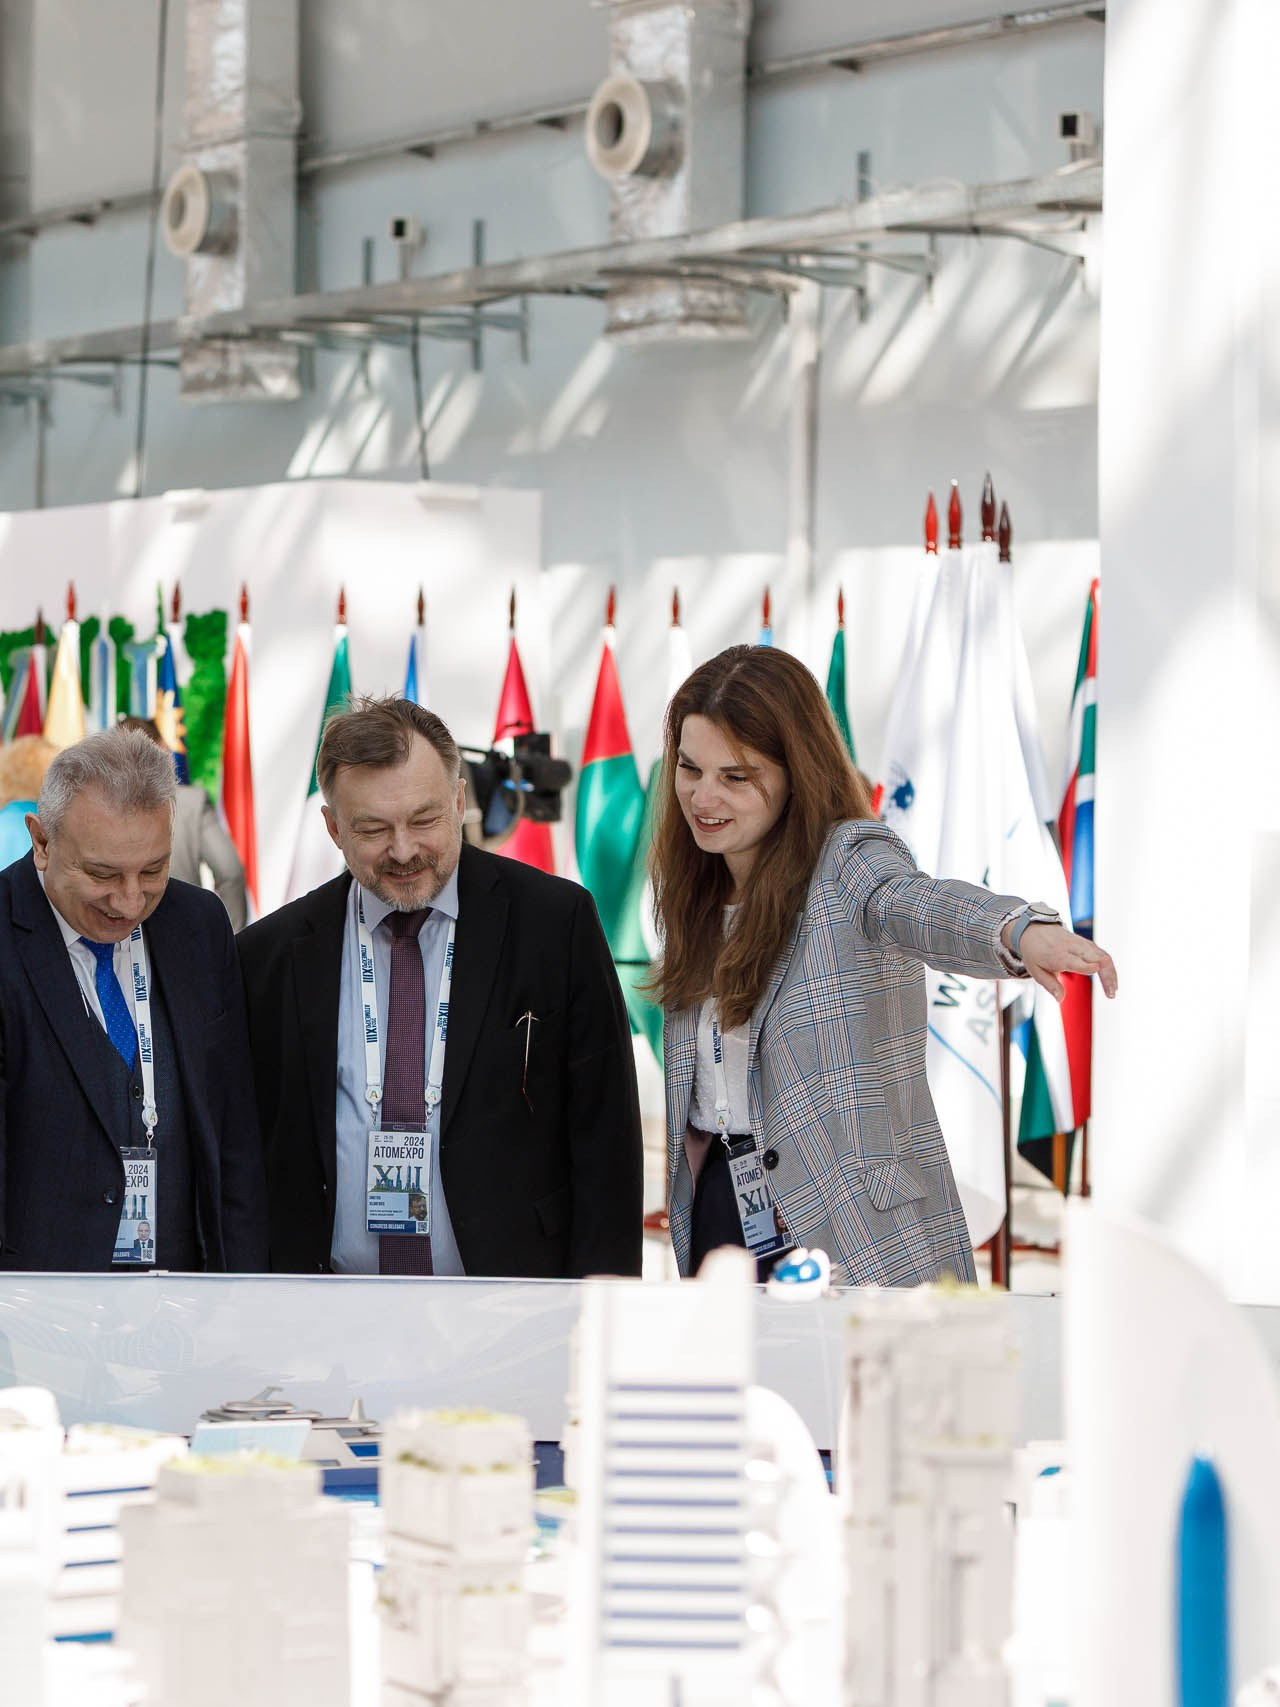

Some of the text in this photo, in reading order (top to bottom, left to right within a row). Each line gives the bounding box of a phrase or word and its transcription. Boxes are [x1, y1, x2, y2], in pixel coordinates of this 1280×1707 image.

[362, 967, 374, 983] XIII
[135, 985, 148, 1002] XIII
[366, 1027, 378, 1043] XIII
[141, 1047, 152, 1063] XIII
[403, 1136, 425, 1147] 2024
[373, 1146, 425, 1159] ATOMEXPO
[128, 1164, 149, 1175] 2024
[736, 1167, 765, 1187] ATOMEX
[125, 1175, 149, 1188] EXPO
